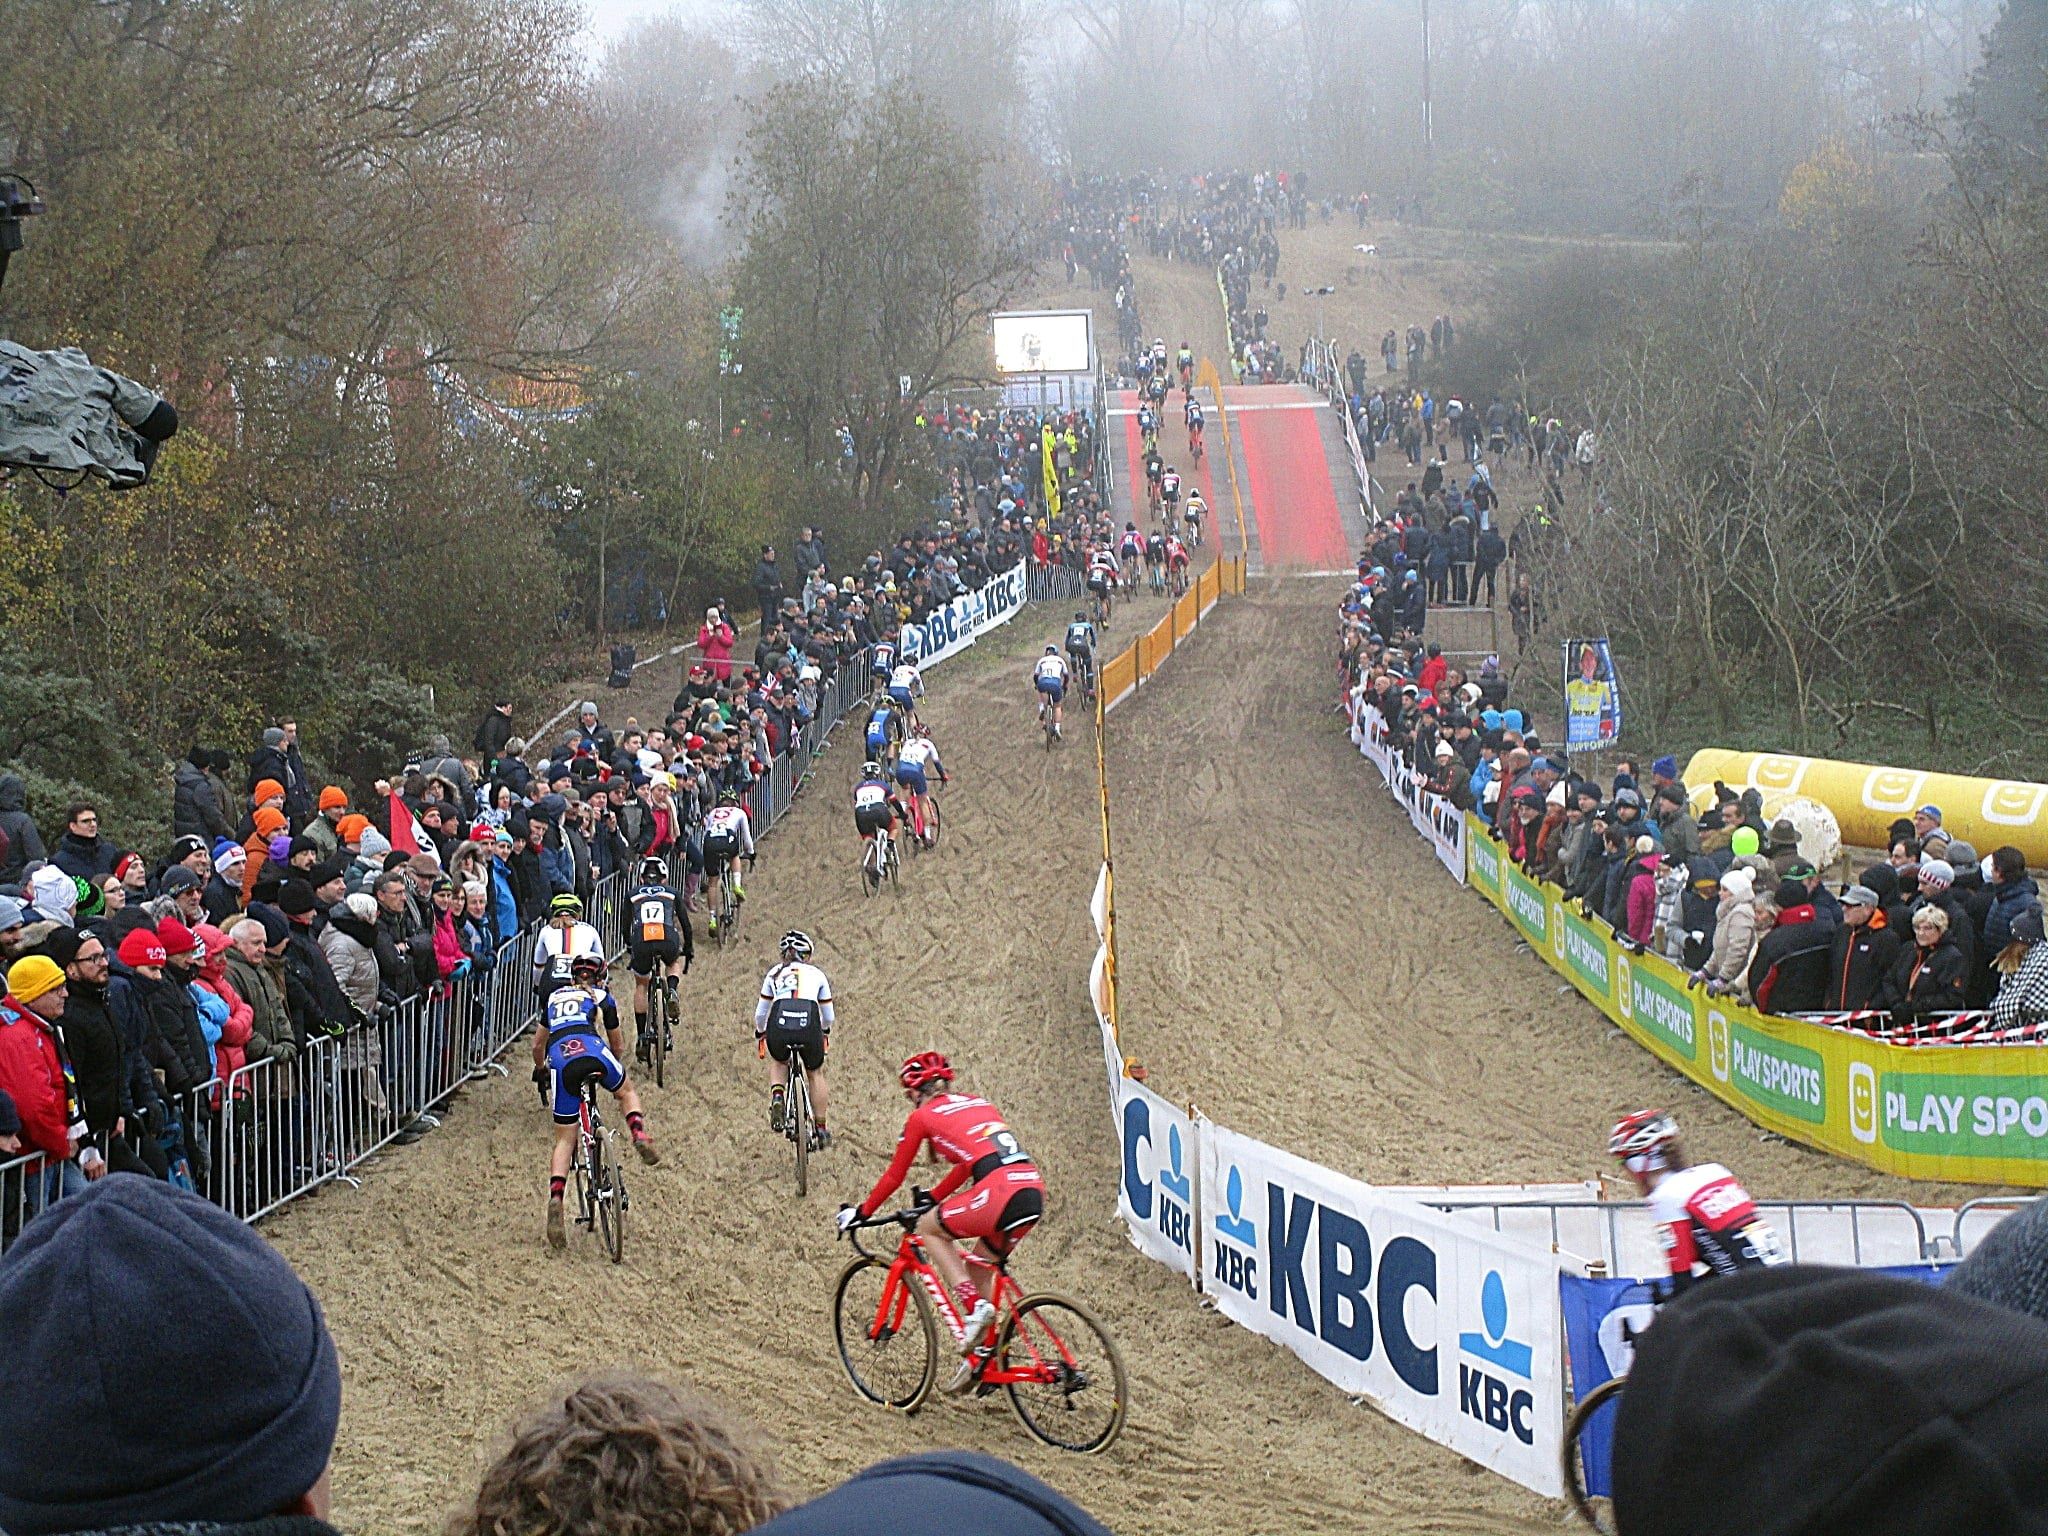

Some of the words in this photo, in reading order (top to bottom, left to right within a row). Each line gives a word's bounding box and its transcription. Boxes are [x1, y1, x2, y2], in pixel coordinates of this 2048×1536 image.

[973, 612, 985, 627] KBC
[985, 574, 1017, 620] KBC
[916, 607, 957, 659] KBC
[960, 621, 972, 638] KBC
[646, 907, 660, 918] 17
[554, 1000, 579, 1018] 10
[1634, 980, 1656, 1019] PLAY
[1655, 996, 1693, 1044] SPORTS
[1733, 1039, 1762, 1083] PLAY
[1762, 1057, 1820, 1105] SPORTS
[1885, 1091, 1965, 1134] PLAY
[997, 1132, 1018, 1155] 9
[1215, 1240, 1257, 1300] KBC
[1267, 1181, 1438, 1396] KBC
[1459, 1363, 1534, 1446] KBC
